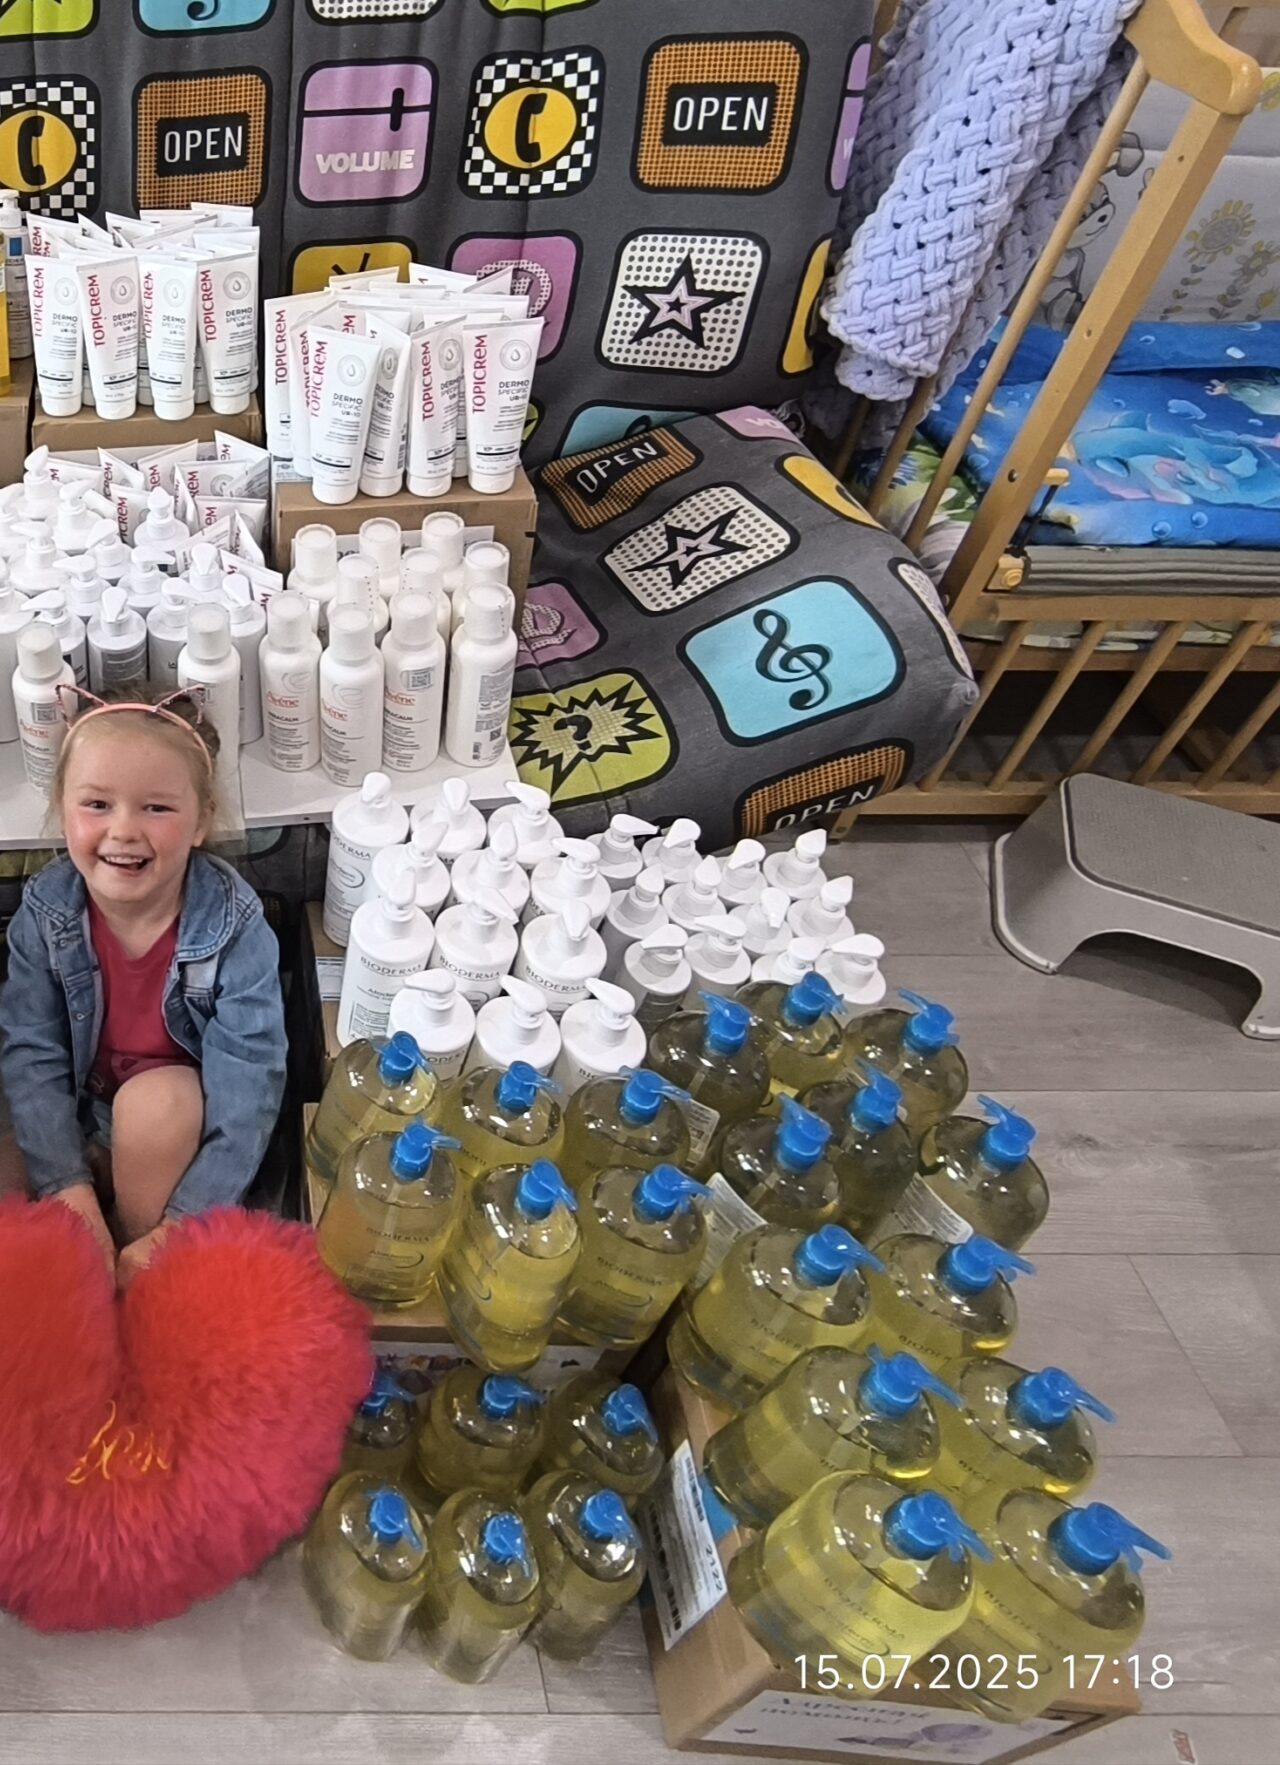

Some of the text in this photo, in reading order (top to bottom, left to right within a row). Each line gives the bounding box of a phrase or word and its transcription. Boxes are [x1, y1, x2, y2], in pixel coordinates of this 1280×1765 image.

[672, 95, 769, 132] OPEN
[163, 125, 243, 163] OPEN
[315, 149, 415, 174] VOLUME
[112, 311, 137, 322] DERMO
[225, 307, 253, 317] DERMO
[498, 379, 530, 389] DERMO
[333, 393, 363, 405] DERMO
[576, 441, 658, 494] OPEN
[774, 785, 874, 830] OPEN
[360, 955, 422, 977] BIODERMA
[439, 955, 501, 980] BIODERMA
[526, 965, 588, 992] BIODERMA
